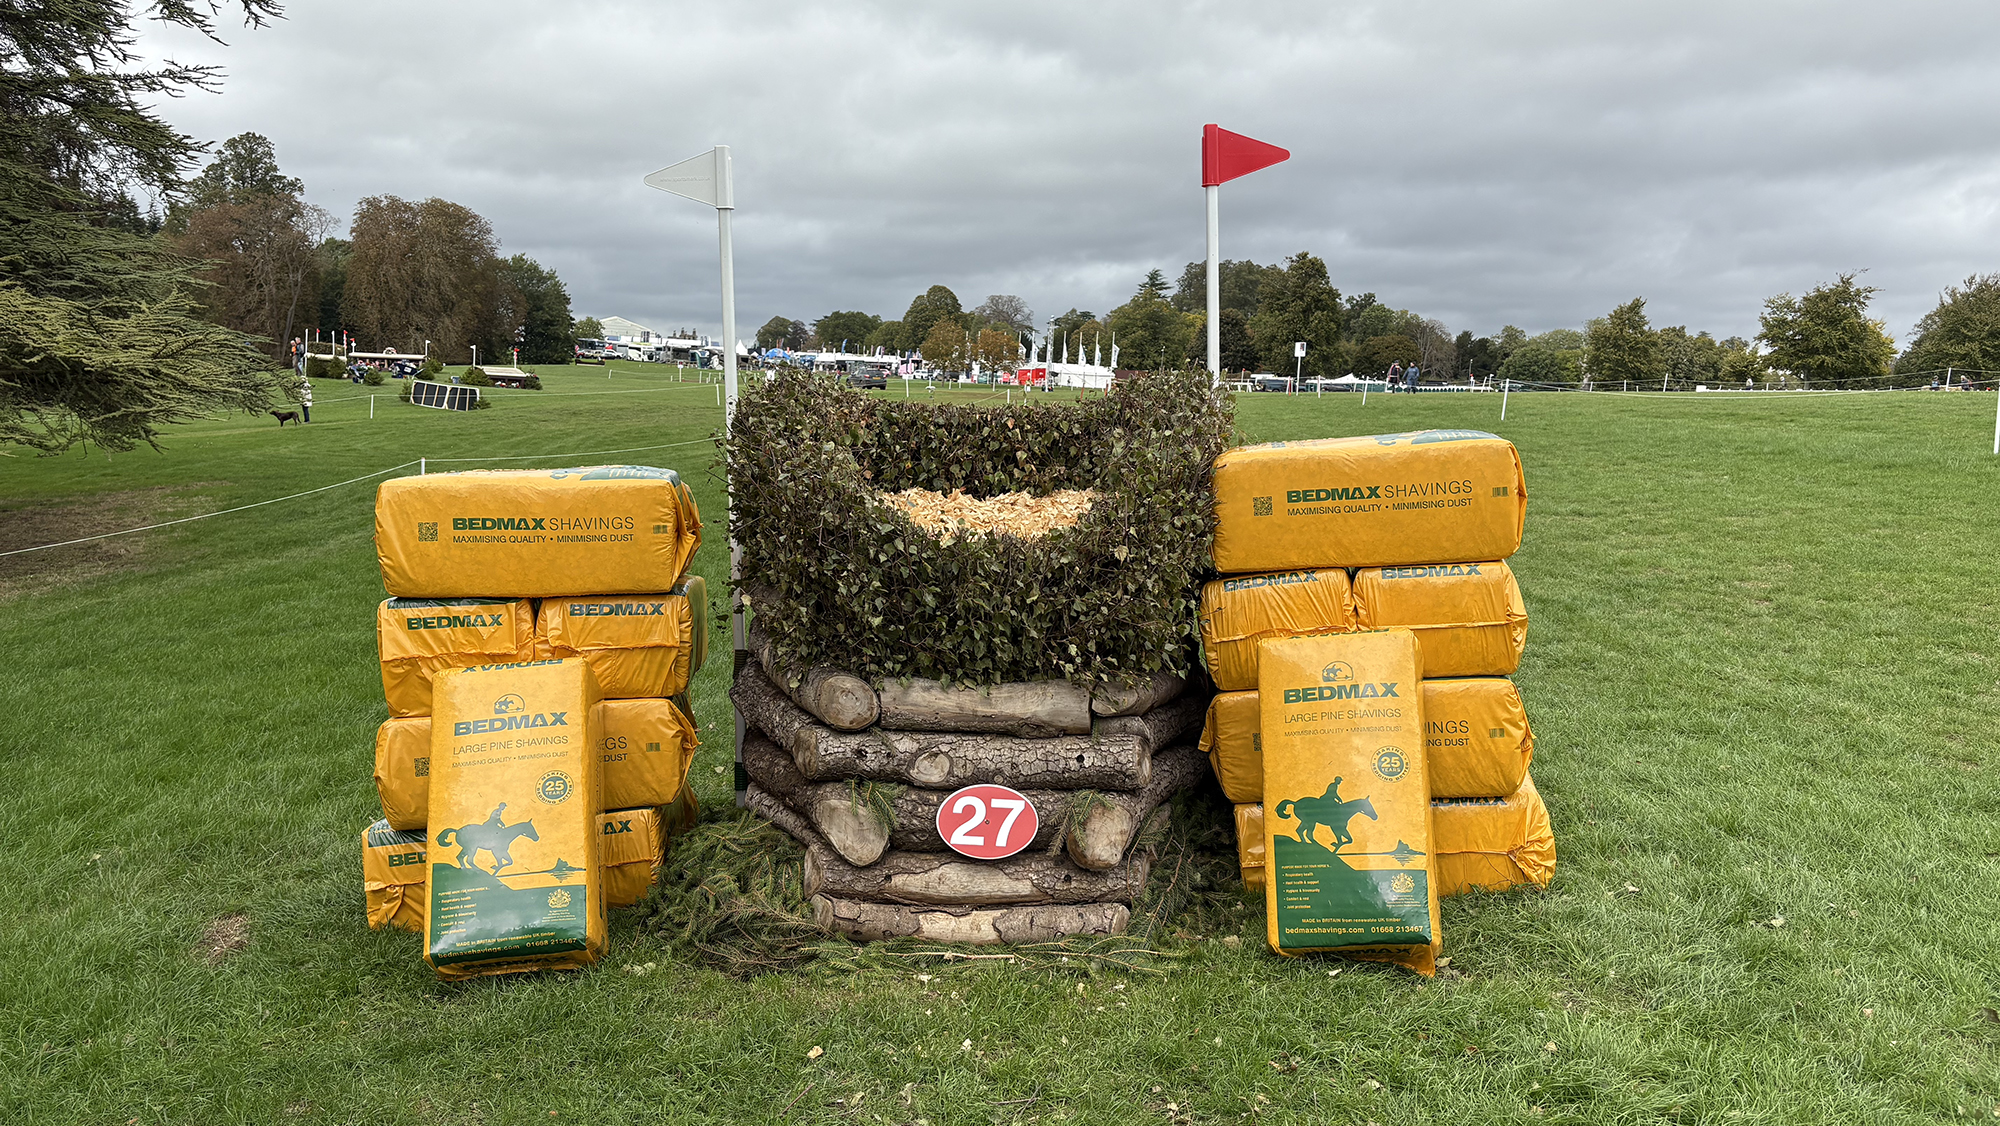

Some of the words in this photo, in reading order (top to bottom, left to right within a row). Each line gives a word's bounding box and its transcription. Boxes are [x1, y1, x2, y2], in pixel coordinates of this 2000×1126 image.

[1287, 486, 1381, 503] BEDMAX
[1384, 480, 1473, 499] SHAVINGS
[1288, 505, 1341, 516] MAXIMISING
[1344, 504, 1382, 514] QUALITY
[1392, 500, 1445, 511] MINIMISING
[1448, 498, 1472, 507] DUST
[453, 518, 546, 530] BEDMAX
[550, 516, 634, 530] SHAVINGS
[453, 535, 506, 544] MAXIMISING
[509, 535, 546, 544] QUALITY
[557, 534, 608, 543] MINIMISING
[610, 534, 634, 542] DUST
[1382, 564, 1482, 580] BEDMAX
[1224, 570, 1318, 592] BEDMAX
[569, 603, 664, 616] BEDMAX
[407, 614, 503, 630] BEDMAX
[1284, 683, 1400, 704] BEDMAX
[1284, 712, 1318, 724] LARGE
[1320, 711, 1344, 720] PINE
[1347, 708, 1401, 720] SHAVINGS
[454, 712, 568, 736] BEDMAX
[1426, 720, 1470, 734] INGS
[454, 743, 486, 756] LARGE
[490, 740, 513, 751] PINE
[516, 736, 568, 748] SHAVINGS
[1444, 738, 1470, 746] DUST
[518, 752, 551, 761] MINIMISING
[604, 753, 628, 762] DUST
[1381, 756, 1400, 768] 25
[546, 780, 564, 792] 25
[950, 796, 1026, 848] 27
[388, 852, 426, 867] BED
[1286, 926, 1364, 934] bedmaxshavings.com
